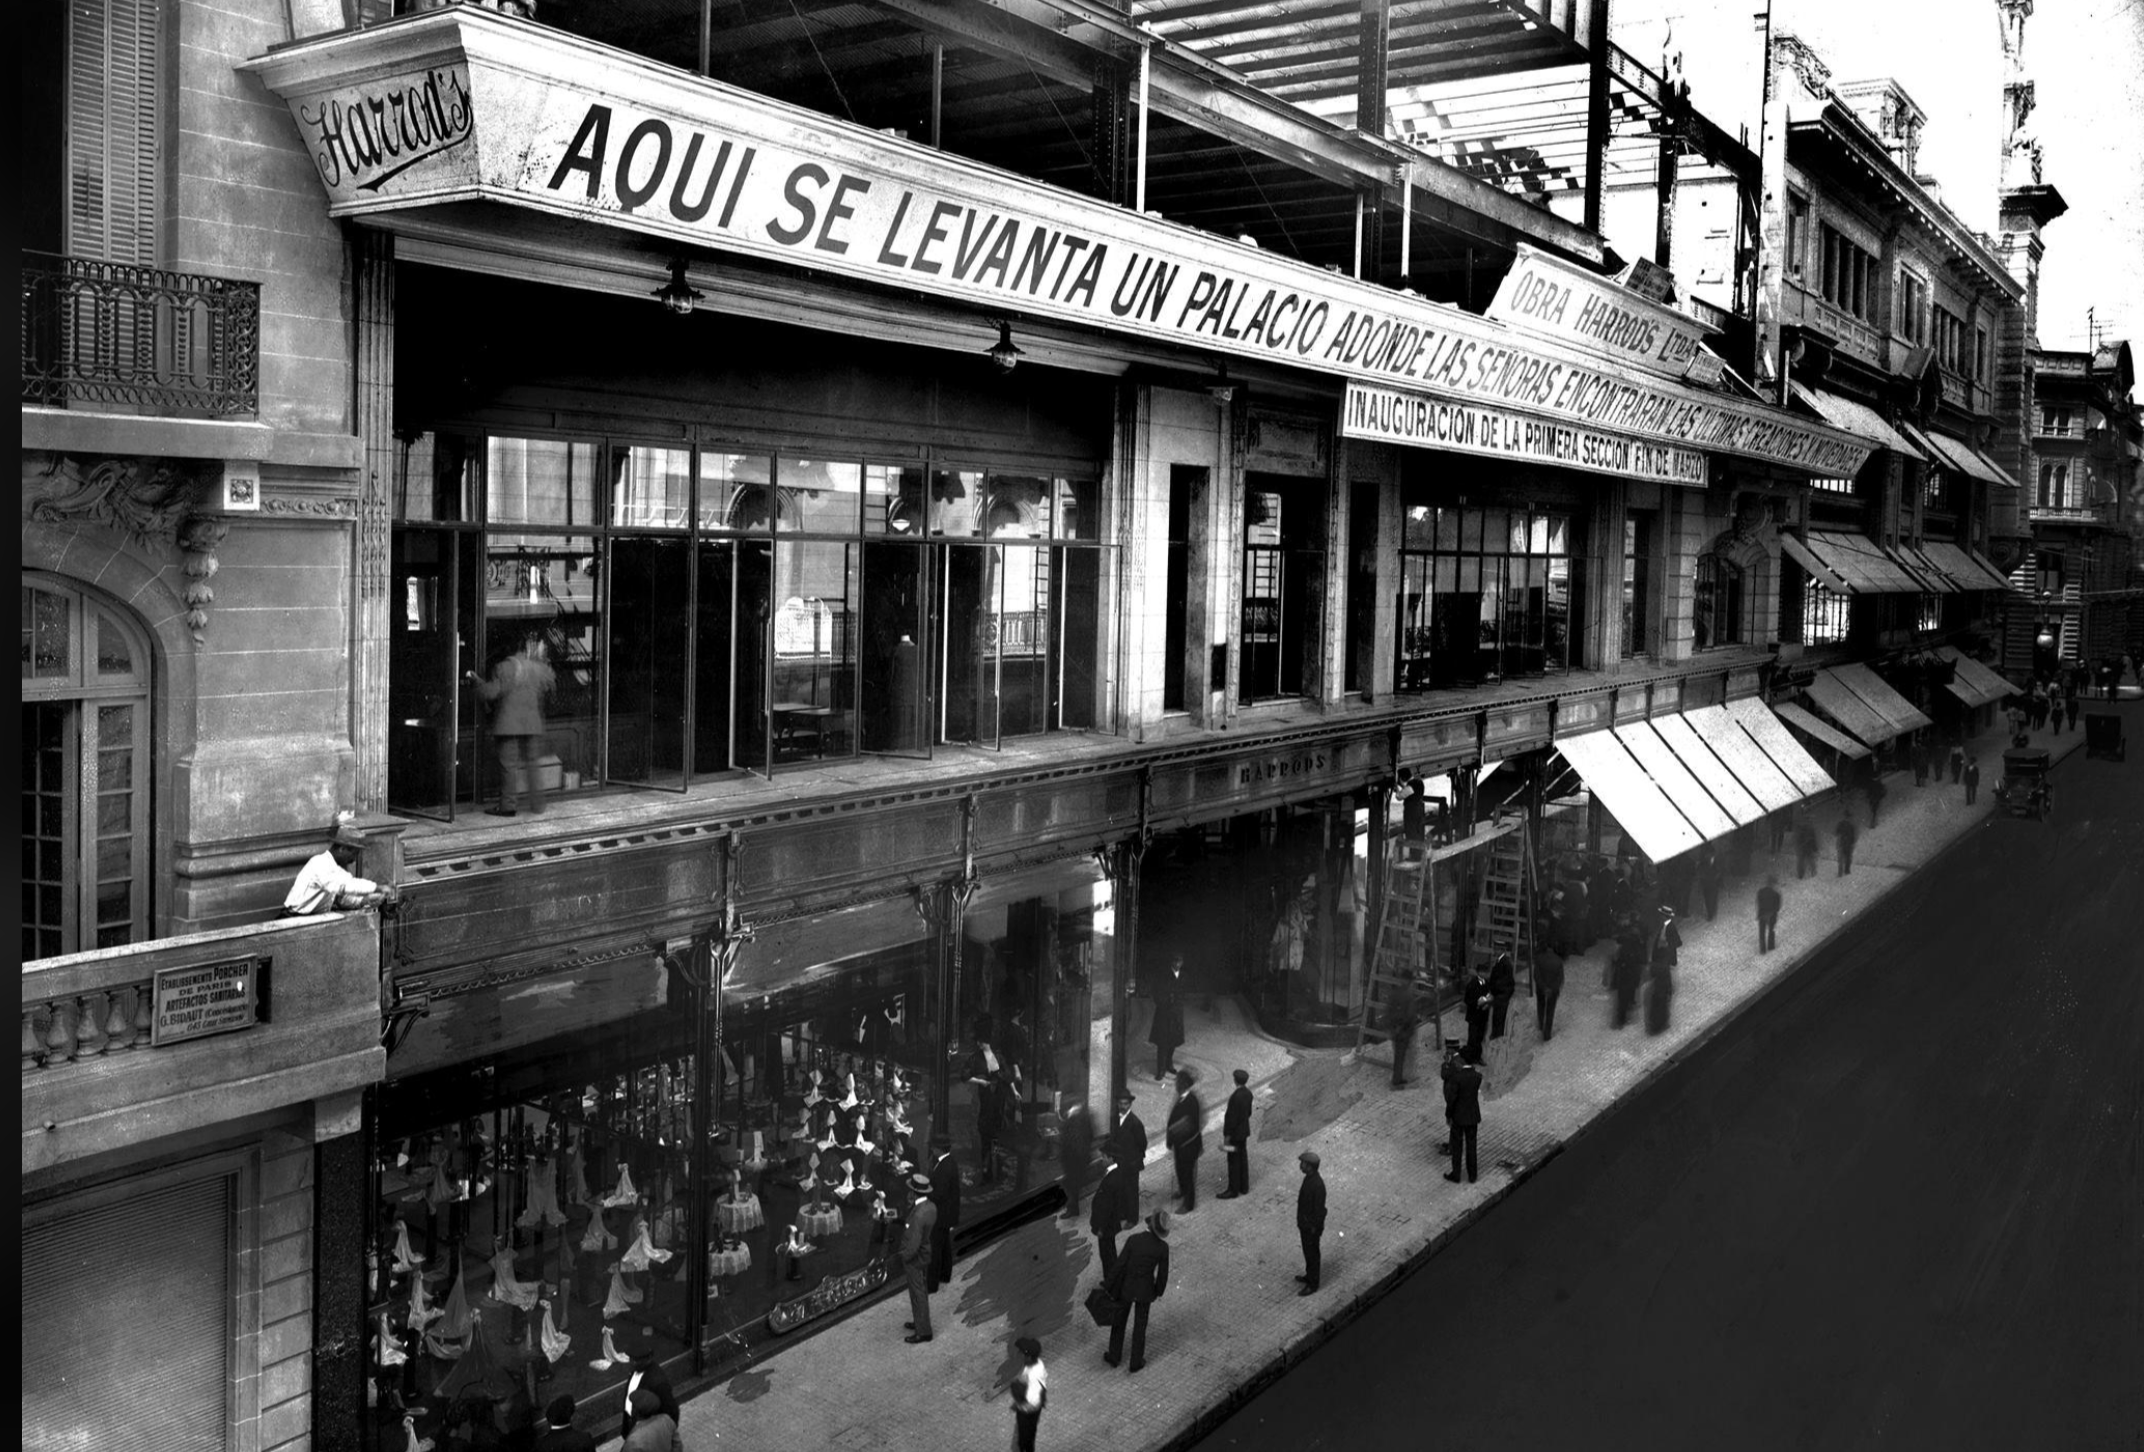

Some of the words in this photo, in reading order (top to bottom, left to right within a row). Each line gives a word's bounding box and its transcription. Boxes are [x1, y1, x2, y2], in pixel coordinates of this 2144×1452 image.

[300, 70, 473, 191] Harrod's
[547, 103, 757, 229] AQUI
[765, 162, 872, 255] SE
[877, 190, 1109, 308] LEVANTA
[1110, 252, 1181, 323] UN
[1176, 270, 1330, 356] PALACIO
[1324, 310, 1435, 378] ADONDE
[1422, 334, 1477, 388] LAS
[1553, 370, 1677, 432] ENCONTRARAN
[1666, 402, 1703, 438] LAS
[1693, 408, 1751, 448] ULTIMAS
[1742, 419, 1811, 460] CREACIONES
[1801, 434, 1817, 464] Y
[1510, 269, 1572, 325] OBRA
[1574, 292, 1660, 355] HARROD'S
[1347, 389, 1475, 446] INAUGURACION
[1480, 414, 1498, 449] DE
[1503, 418, 1521, 452] LA
[1525, 422, 1579, 462] PRIMERA
[1582, 434, 1630, 471] SECCION
[1634, 444, 1652, 474] FIN
[1655, 448, 1669, 476] DE
[1671, 451, 1702, 481] MARZO
[165, 993, 209, 1013] ARTEFACTOS
[179, 987, 194, 996] DE
[197, 981, 232, 993] PARIS
[213, 963, 249, 980] PORCHER
